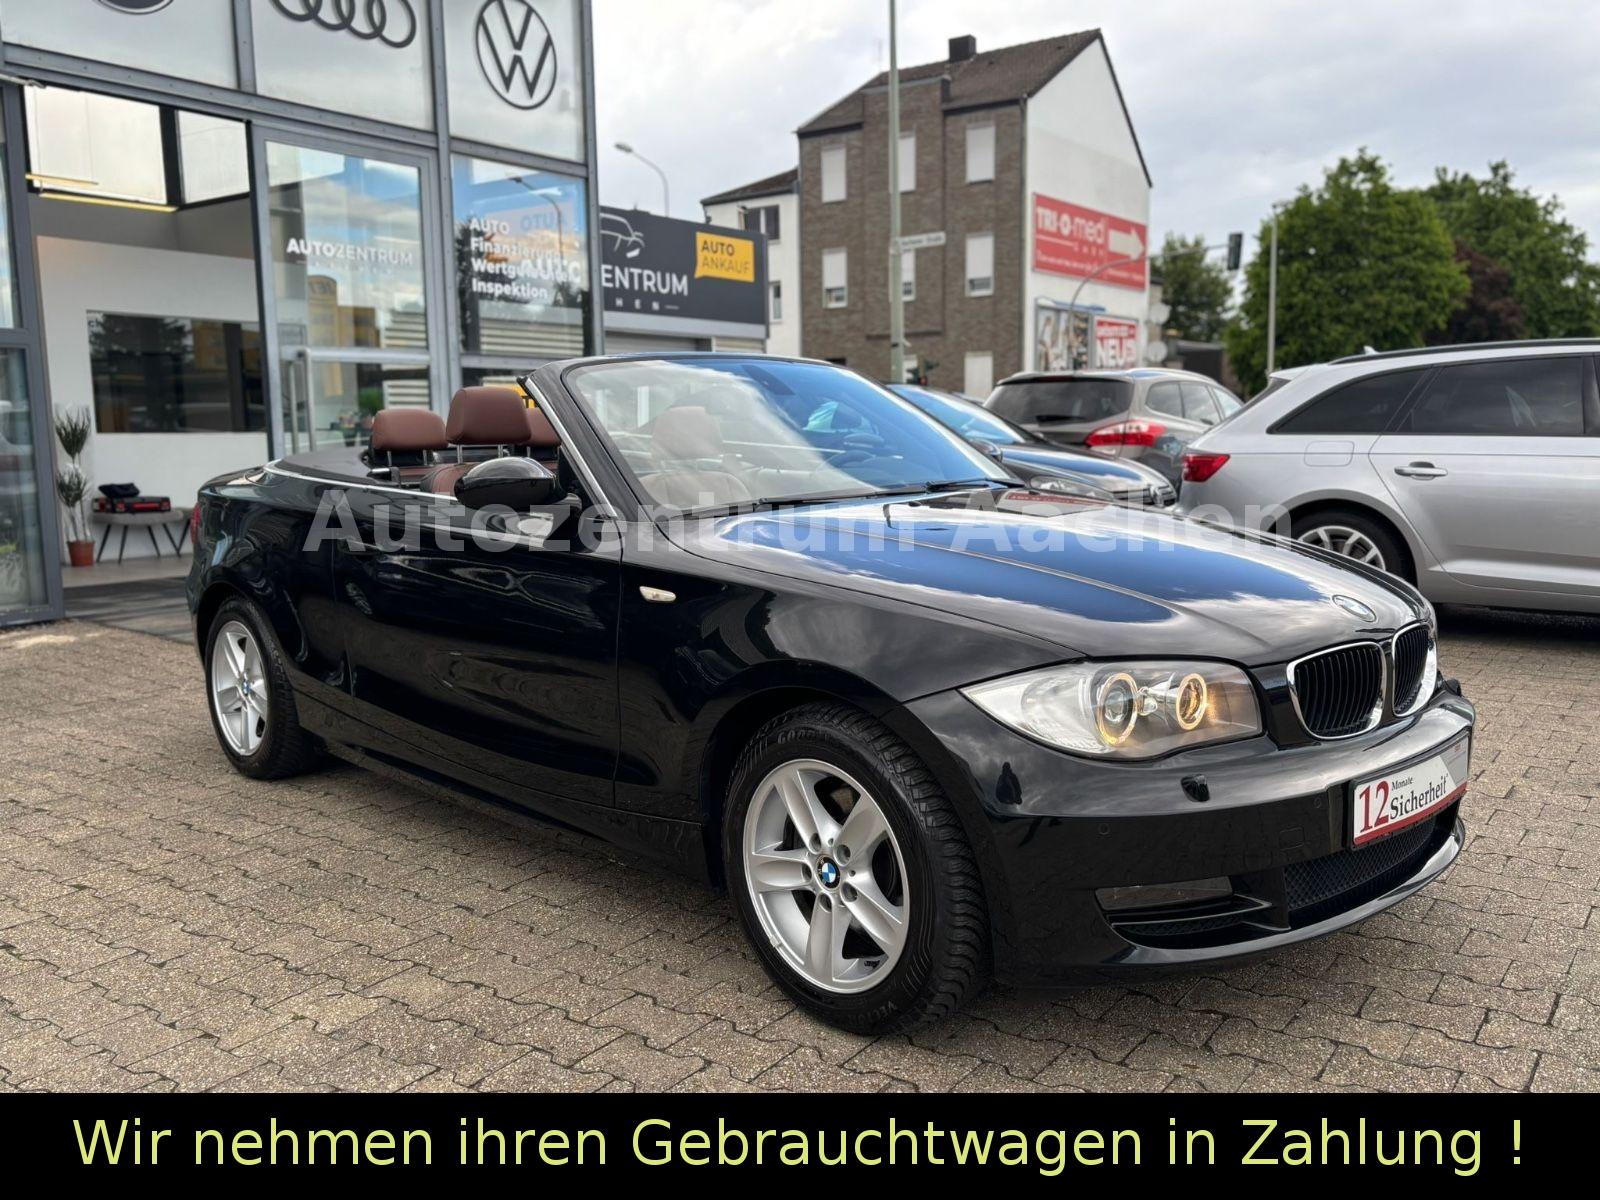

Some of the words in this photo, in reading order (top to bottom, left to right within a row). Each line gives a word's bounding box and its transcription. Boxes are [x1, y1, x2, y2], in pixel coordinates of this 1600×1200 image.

[470, 217, 510, 235] AUTO
[286, 237, 413, 265] AUTOZENTRUM
[701, 239, 735, 257] AUTO
[702, 255, 751, 274] ANKAUF
[472, 277, 548, 299] Inspektion
[601, 264, 688, 296] ENTRUM
[615, 297, 661, 311] HEN
[1359, 780, 1390, 833] 12
[1391, 776, 1413, 792] Monate
[1389, 775, 1447, 820] Sicherheit
